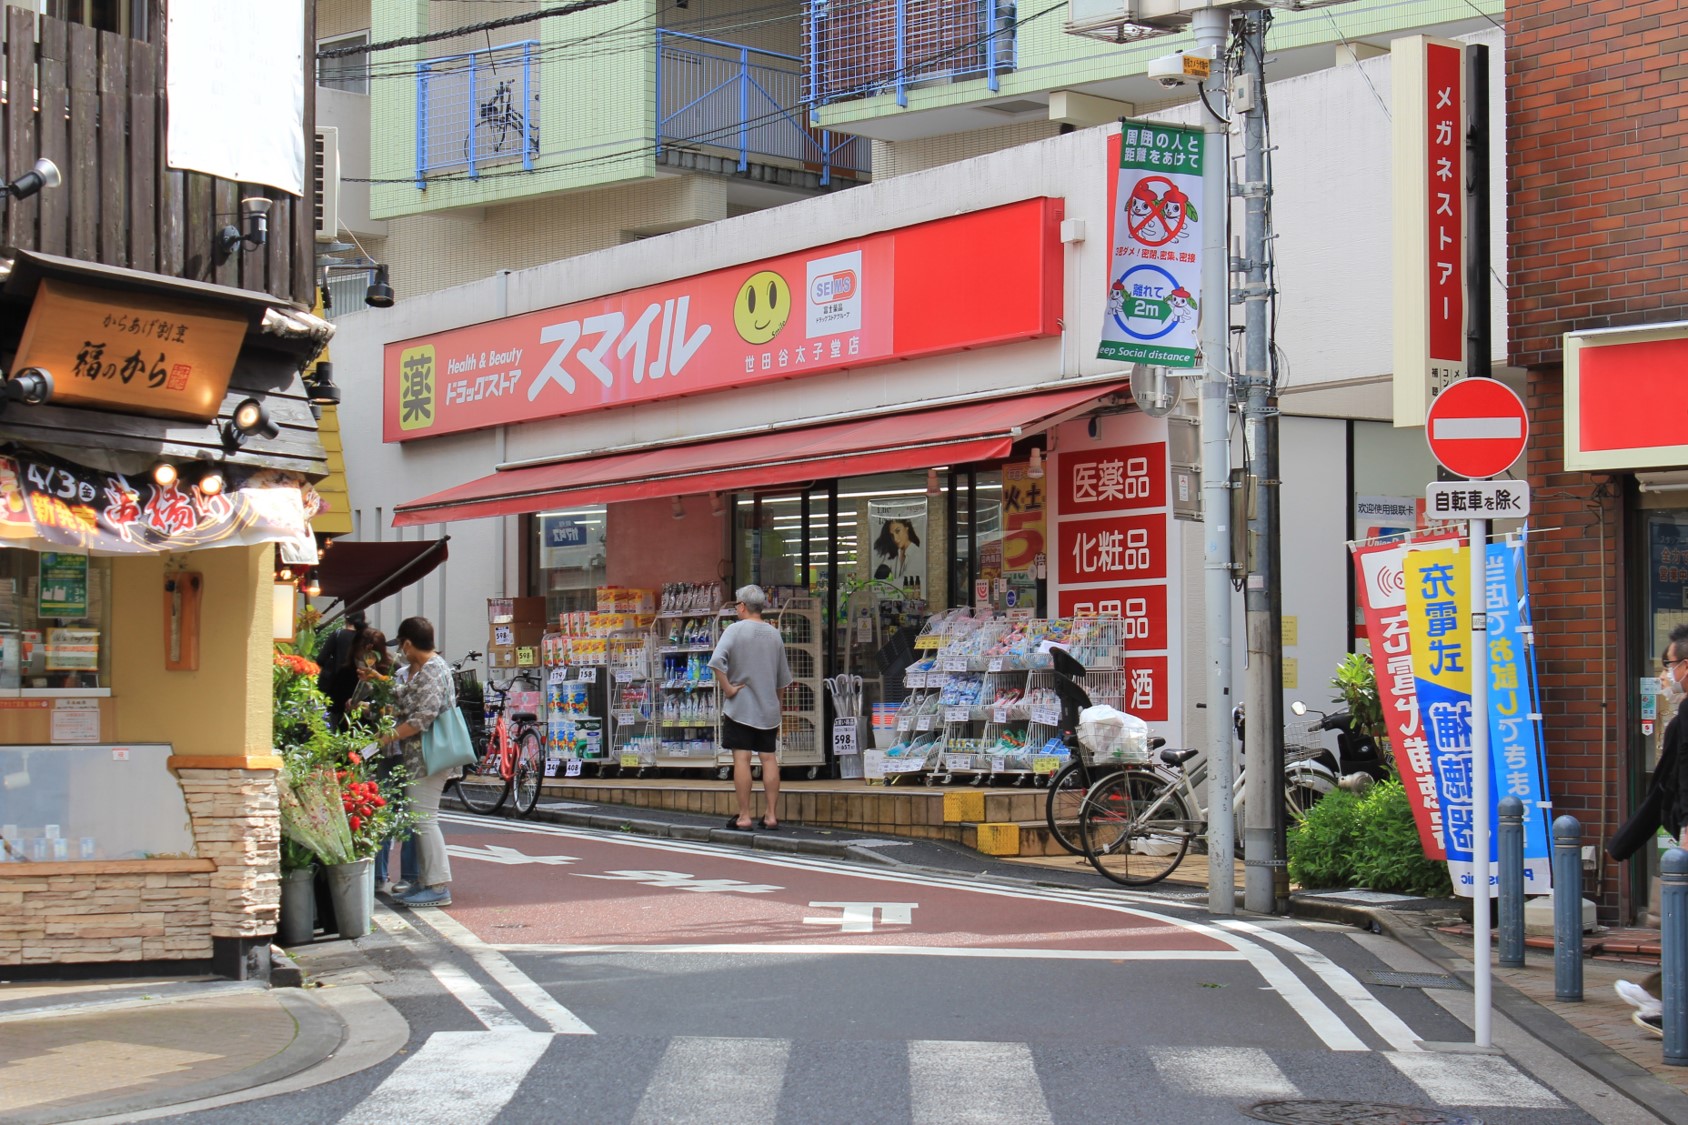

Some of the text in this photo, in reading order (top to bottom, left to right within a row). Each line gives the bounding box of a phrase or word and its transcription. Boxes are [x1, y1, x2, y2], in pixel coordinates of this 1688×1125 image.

[1126, 129, 1199, 152] 周囲の人と
[1124, 147, 1199, 168] 距離をあけて
[1435, 85, 1453, 320] メガネストアー
[816, 277, 851, 298] SEIMS
[1133, 283, 1164, 299] 離れて
[1134, 300, 1159, 317] 2m
[103, 313, 189, 344] からあげ割烹
[448, 348, 523, 375] Health & Beauty
[527, 295, 712, 402] スマイル
[745, 336, 860, 373] 世田谷太子堂店
[1100, 346, 1191, 362] eep Social distance
[71, 340, 168, 388] 福のから
[402, 353, 432, 423] 薬
[446, 369, 522, 405] ドラッグストア
[1073, 456, 1150, 503] 医薬品
[30, 490, 98, 534] 新発売
[1358, 503, 1415, 516] 欢迎使用银联卡
[1435, 489, 1522, 512] 自転車を除く
[1073, 528, 1150, 573] 化粧品
[835, 734, 851, 745] 598
